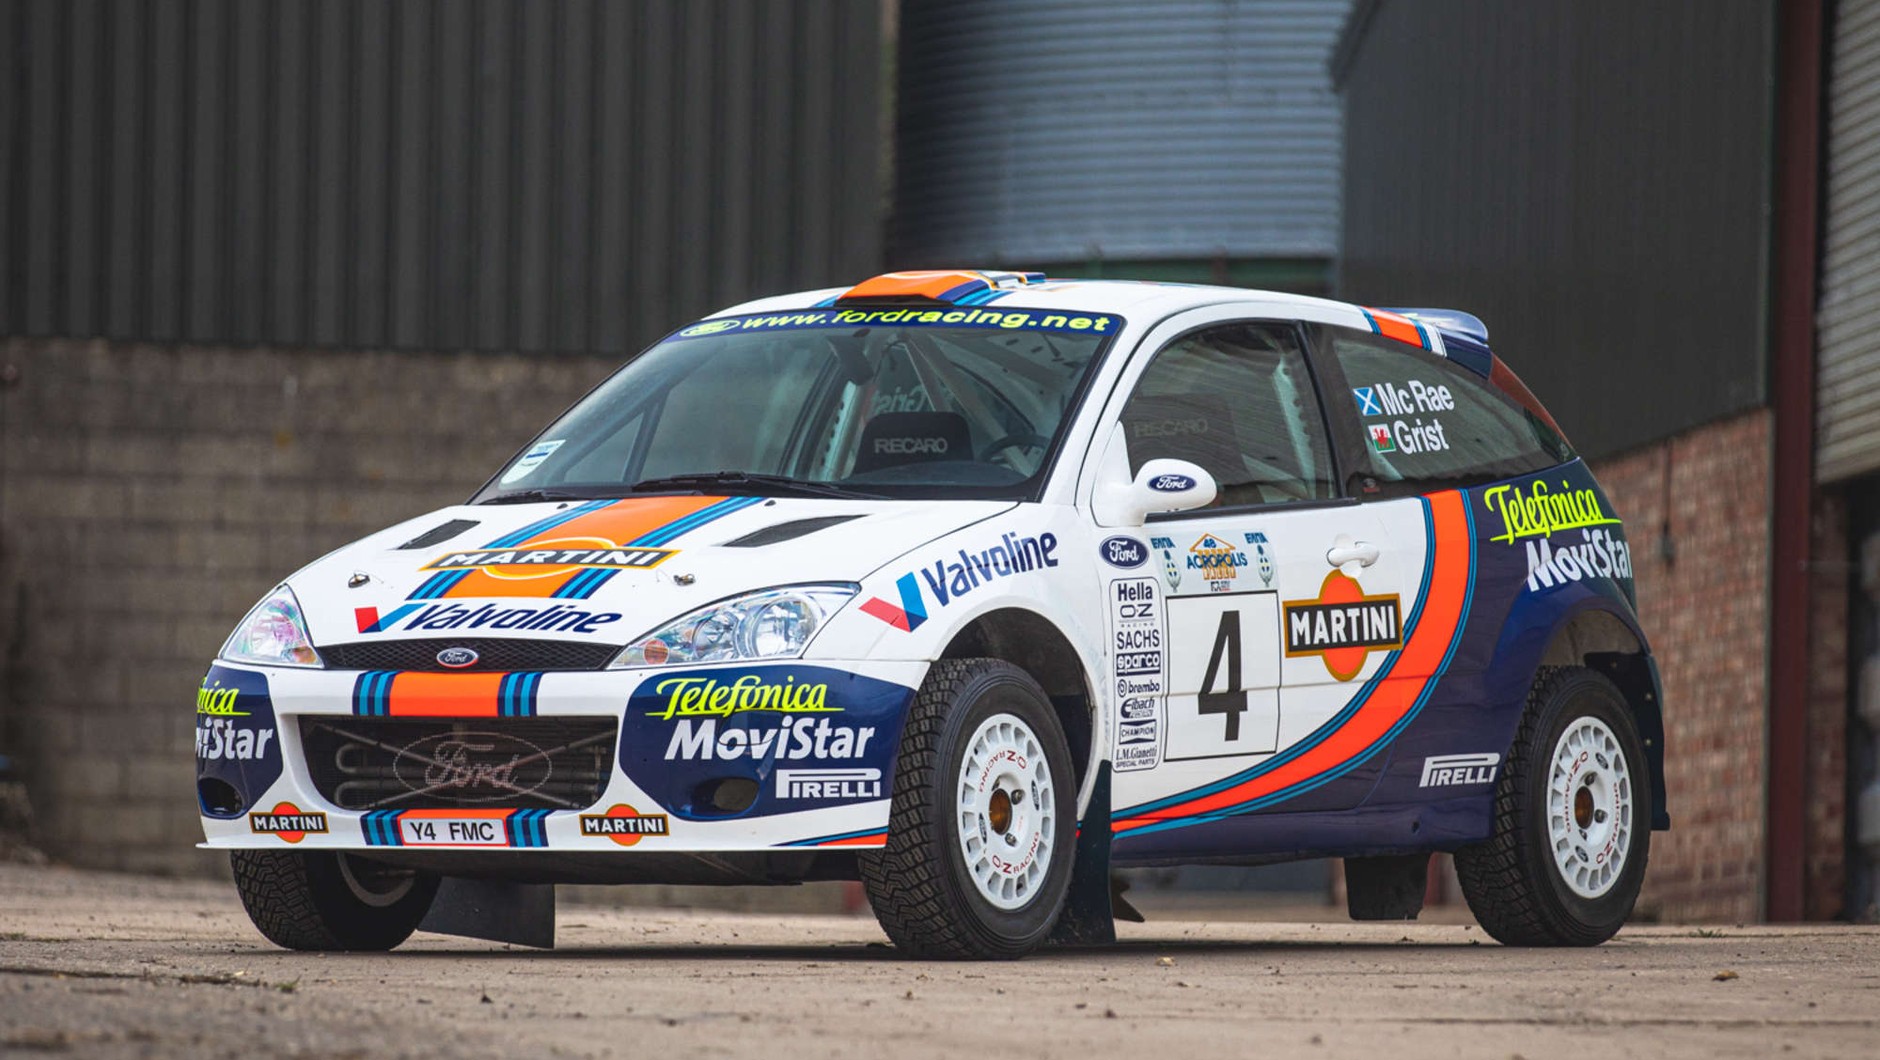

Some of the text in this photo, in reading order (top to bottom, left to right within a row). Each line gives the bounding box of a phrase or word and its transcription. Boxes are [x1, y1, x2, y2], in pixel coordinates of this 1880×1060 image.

[742, 309, 1110, 332] www.fordracing.net
[1375, 379, 1455, 416] Mc Rae
[873, 436, 948, 454] RECARO
[1393, 418, 1449, 454] Grist
[1156, 475, 1188, 489] Ford
[440, 550, 661, 566] MARTINI
[1109, 539, 1140, 562] Ford
[1186, 552, 1249, 570] ACROPOLIS
[921, 530, 1059, 608] Valvoline
[1203, 567, 1237, 580] RALLY
[1117, 582, 1153, 602] Hella
[403, 603, 623, 634] Valvoline
[1290, 604, 1396, 647] MARTINI
[1116, 629, 1160, 650] SACHS
[1117, 653, 1160, 672] sparco
[1128, 679, 1160, 694] brembo
[1198, 610, 1248, 742] 4
[1120, 697, 1155, 719] Eibach
[664, 715, 875, 761] MoviStar
[1121, 726, 1154, 738] CHAMPION
[424, 741, 519, 789] Ford
[979, 751, 1006, 793] RACING
[1138, 757, 1155, 766] PARTS
[1419, 752, 1500, 787] PIRELLI
[776, 768, 882, 799] PIRELLI
[253, 815, 324, 831] MARTINI
[410, 822, 495, 841] Y4 FMC
[584, 815, 665, 835] MARTINI
[1013, 831, 1040, 874] RACING
